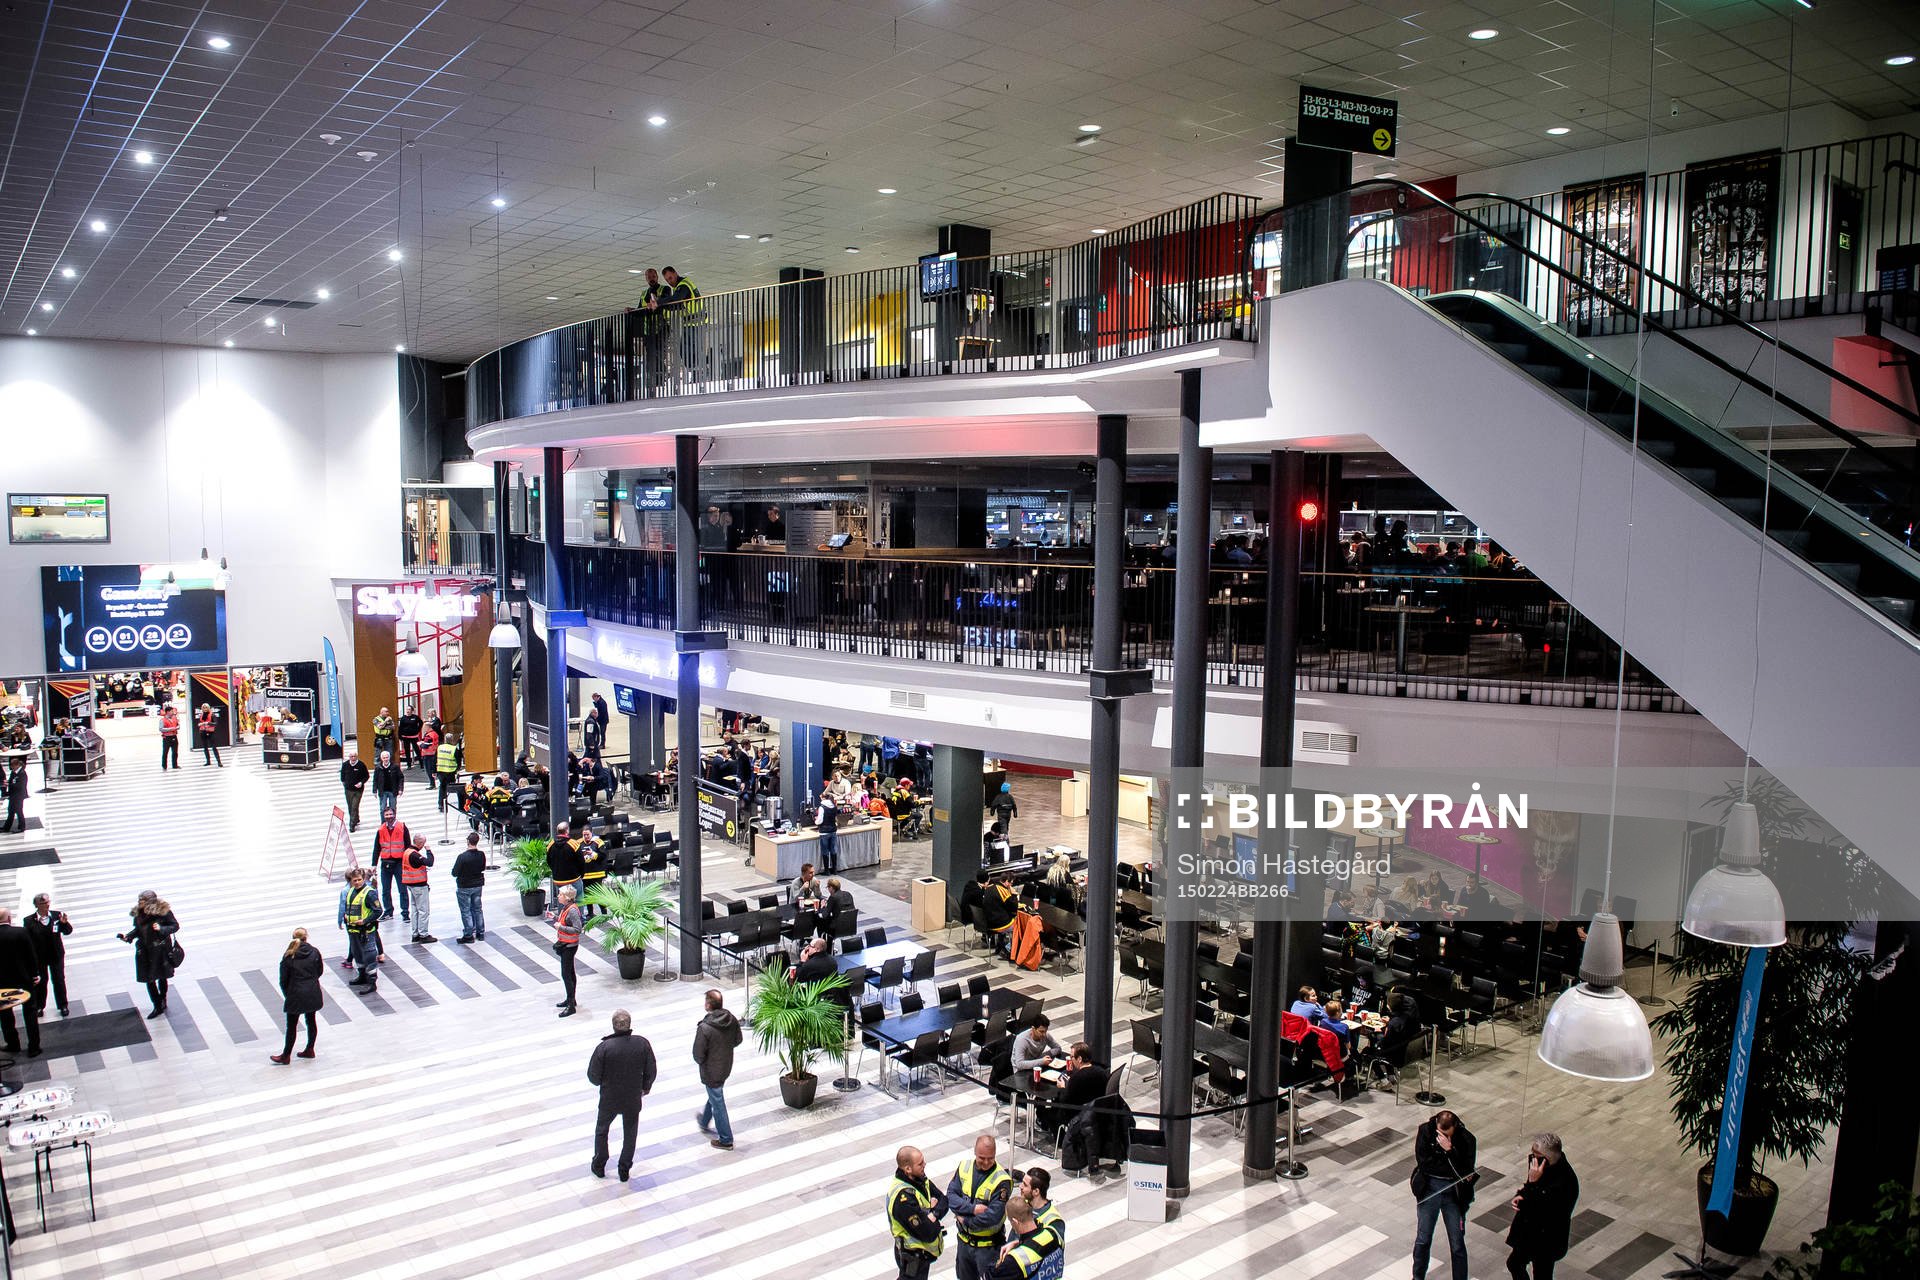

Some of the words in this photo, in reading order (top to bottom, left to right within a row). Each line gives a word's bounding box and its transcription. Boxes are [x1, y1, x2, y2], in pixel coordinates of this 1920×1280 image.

[1302, 94, 1394, 117] J3-K3-L3-M3-N3-O3-P3
[1302, 103, 1370, 125] 1912-Baren
[267, 689, 310, 698] Godispuckar
[698, 800, 727, 819] Restaurang
[1140, 1181, 1163, 1190] STENA
